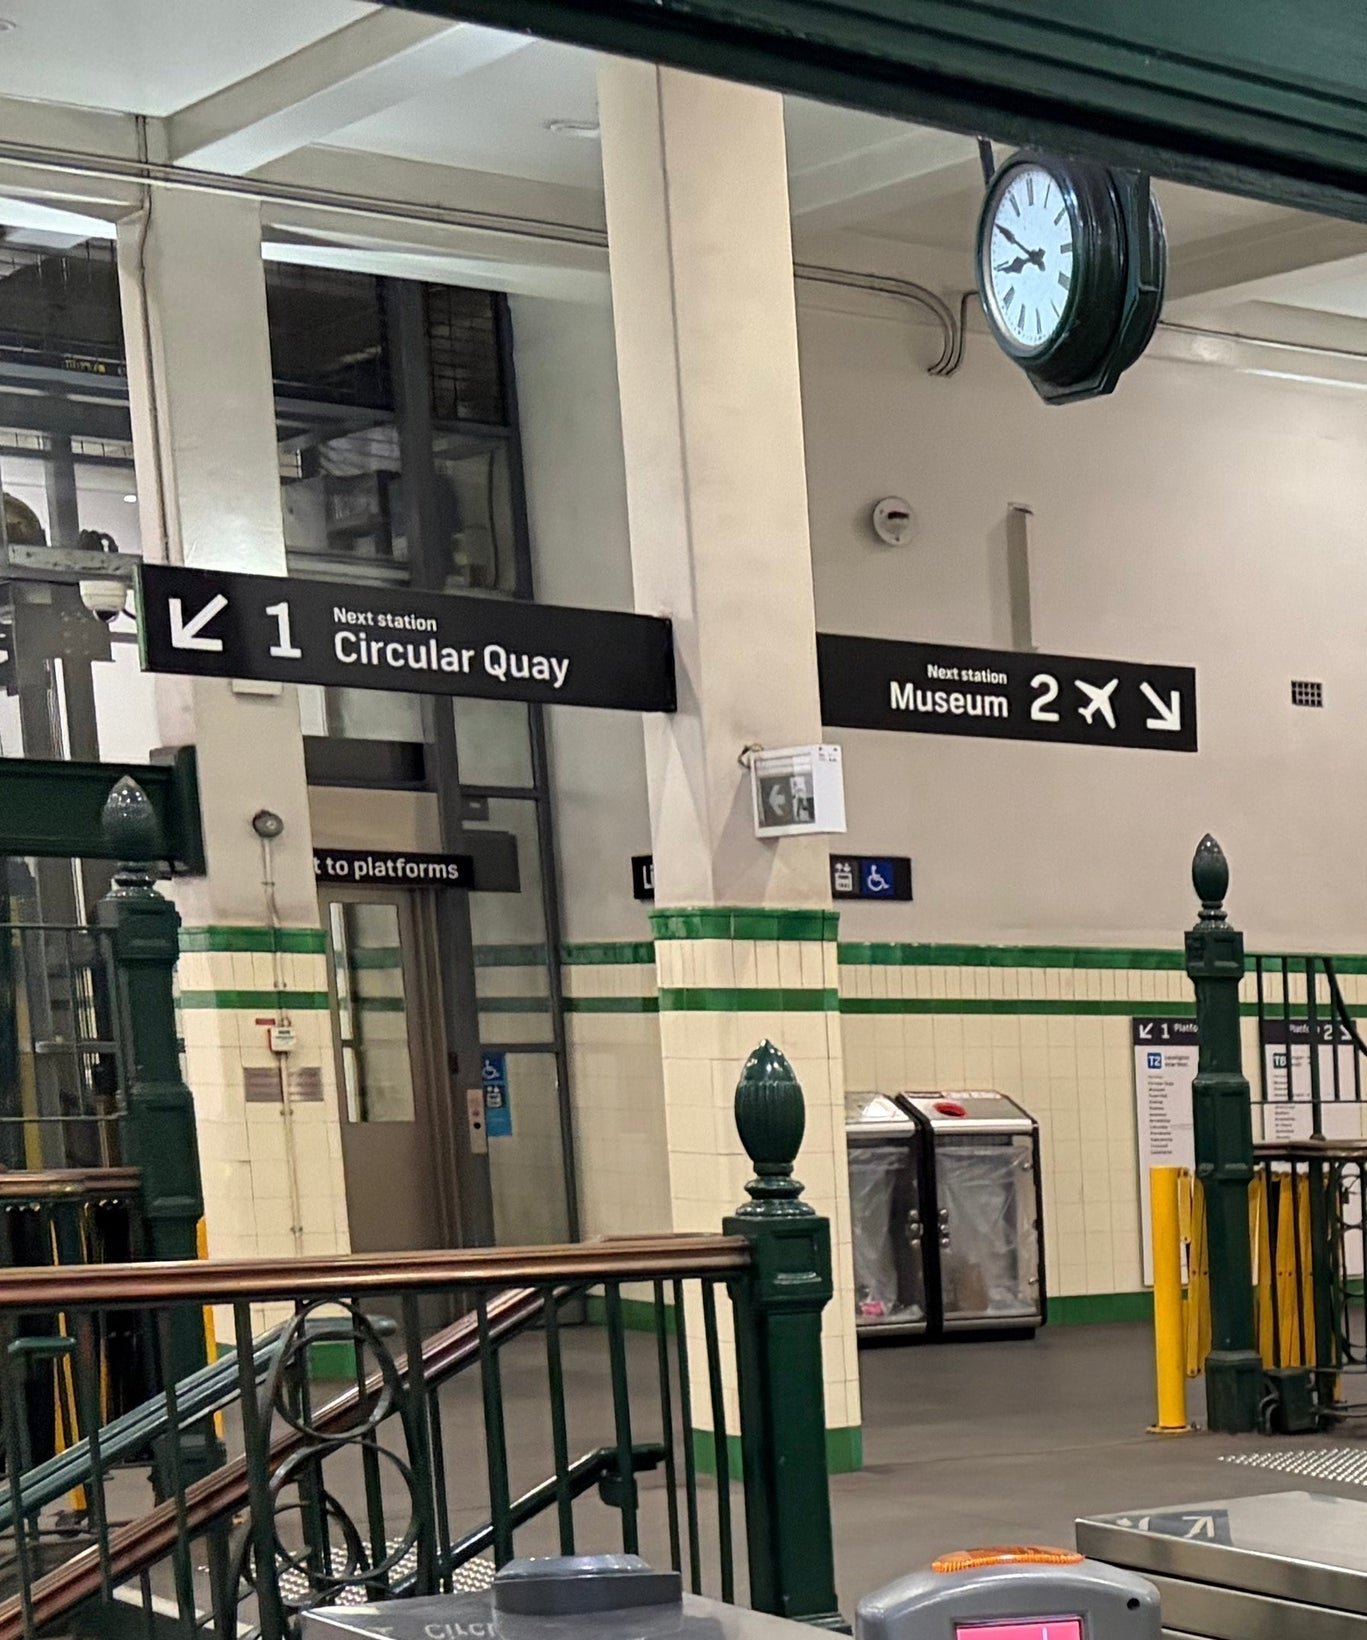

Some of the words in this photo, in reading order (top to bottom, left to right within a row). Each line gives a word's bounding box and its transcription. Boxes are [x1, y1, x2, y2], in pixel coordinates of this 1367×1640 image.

[265, 601, 302, 659] 1
[333, 606, 374, 627] Next
[377, 609, 437, 632] station
[334, 630, 475, 674] Circular
[483, 644, 569, 689] Quay
[927, 664, 960, 681] Next
[961, 666, 1008, 685] station
[889, 681, 1009, 718] Museum
[1030, 673, 1060, 722] 2
[326, 856, 348, 875] to
[354, 856, 459, 880] platforms
[1161, 1023, 1170, 1039] 1
[1173, 1023, 1199, 1033] Platfo
[1323, 1024, 1333, 1040] 2
